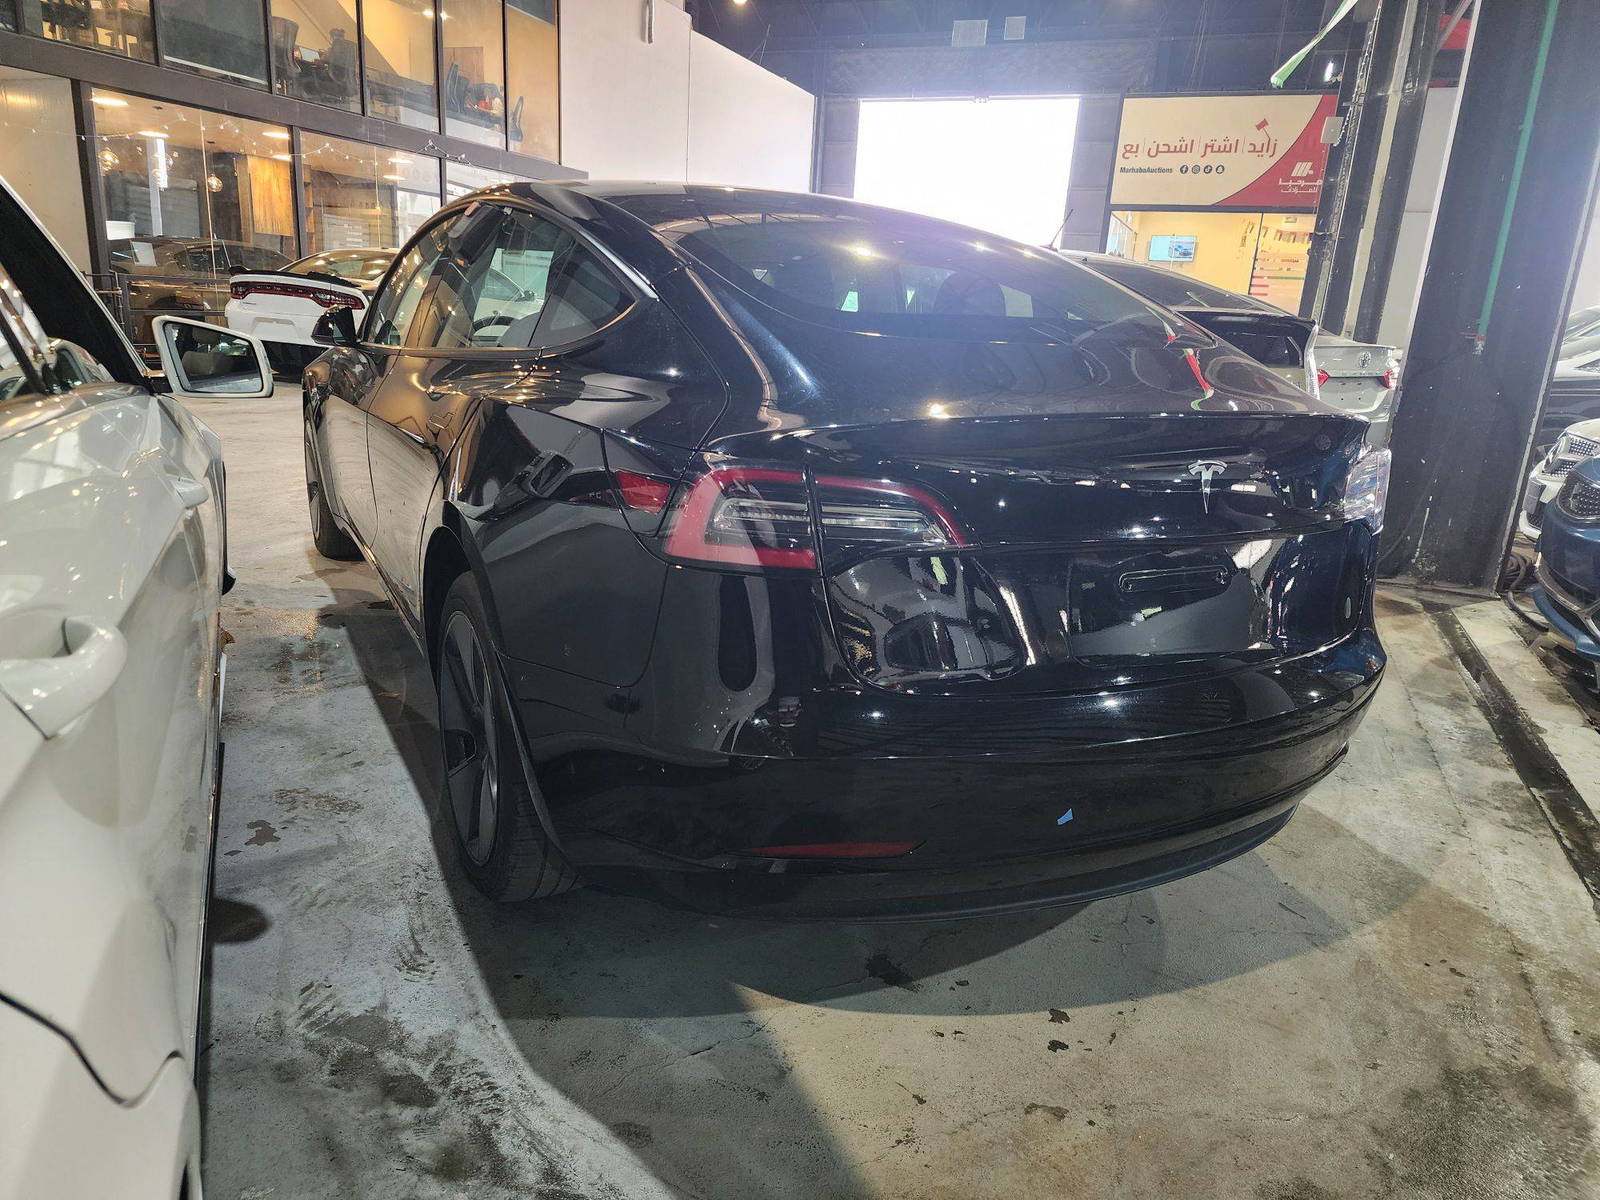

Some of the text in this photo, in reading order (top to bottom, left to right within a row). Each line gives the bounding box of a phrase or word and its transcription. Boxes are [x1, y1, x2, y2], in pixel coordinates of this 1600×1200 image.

[1122, 136, 1278, 160] زايد اشتر اشحن بع
[1119, 166, 1173, 174] MarhabaAuctions
